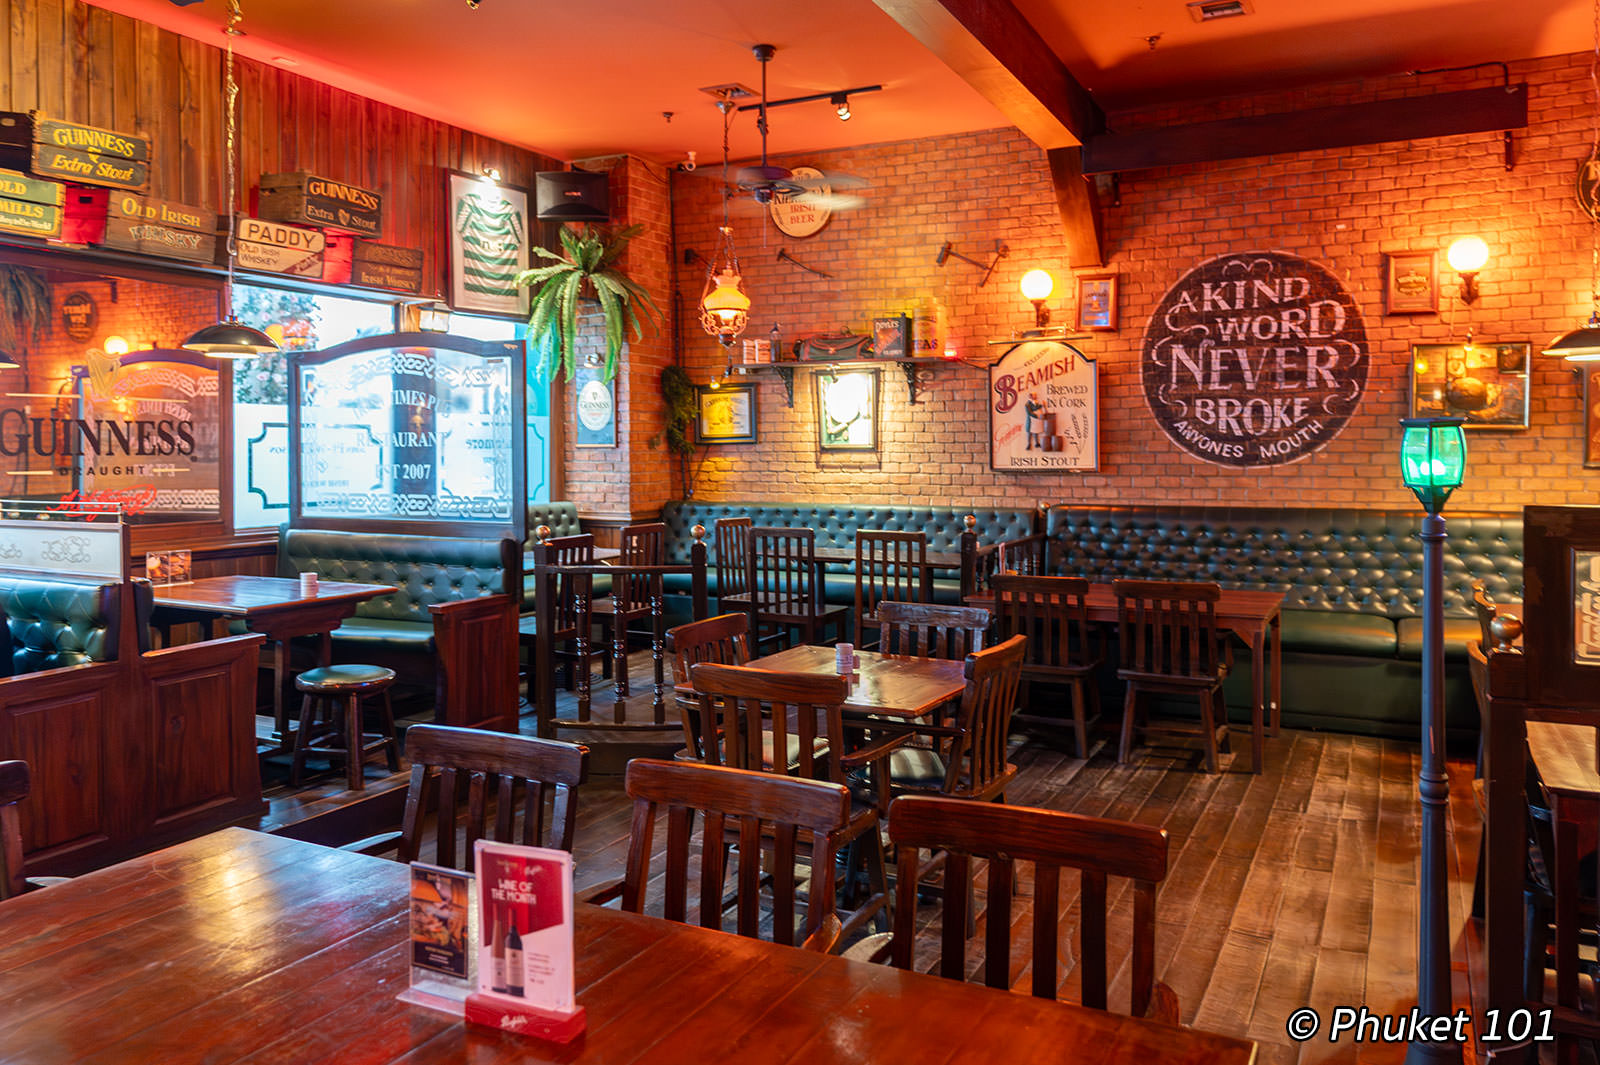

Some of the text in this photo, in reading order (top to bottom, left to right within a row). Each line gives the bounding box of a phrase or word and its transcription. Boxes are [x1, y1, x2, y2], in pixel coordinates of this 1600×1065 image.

[53, 128, 135, 157] GUINNESS
[52, 154, 134, 181] Extra Stout
[309, 182, 378, 210] GUINNESS
[122, 198, 200, 228] OLD IRISH
[307, 205, 376, 230] Extra Stout
[790, 214, 815, 224] BEER
[128, 224, 202, 249] WHISKY
[240, 242, 259, 253] OLD
[248, 223, 317, 248] PADDY
[240, 254, 278, 265] WHISKEY
[1201, 277, 1311, 312] KIND
[1216, 299, 1347, 342] WORD
[1170, 342, 1341, 392] NEVER
[994, 354, 1076, 413] BEAMISH
[1047, 383, 1089, 395] BREWED
[1047, 396, 1087, 408] IN CORK
[1195, 397, 1310, 437] BROKE
[0, 407, 196, 458] GUINNESS
[1173, 419, 1324, 458] ANYONES MOUTH
[59, 465, 145, 477] DRAUGHT
[403, 462, 432, 480] 2007
[1010, 455, 1080, 467] IRISH STOUT
[491, 888, 537, 905] THE MONTH
[519, 881, 534, 893] OF
